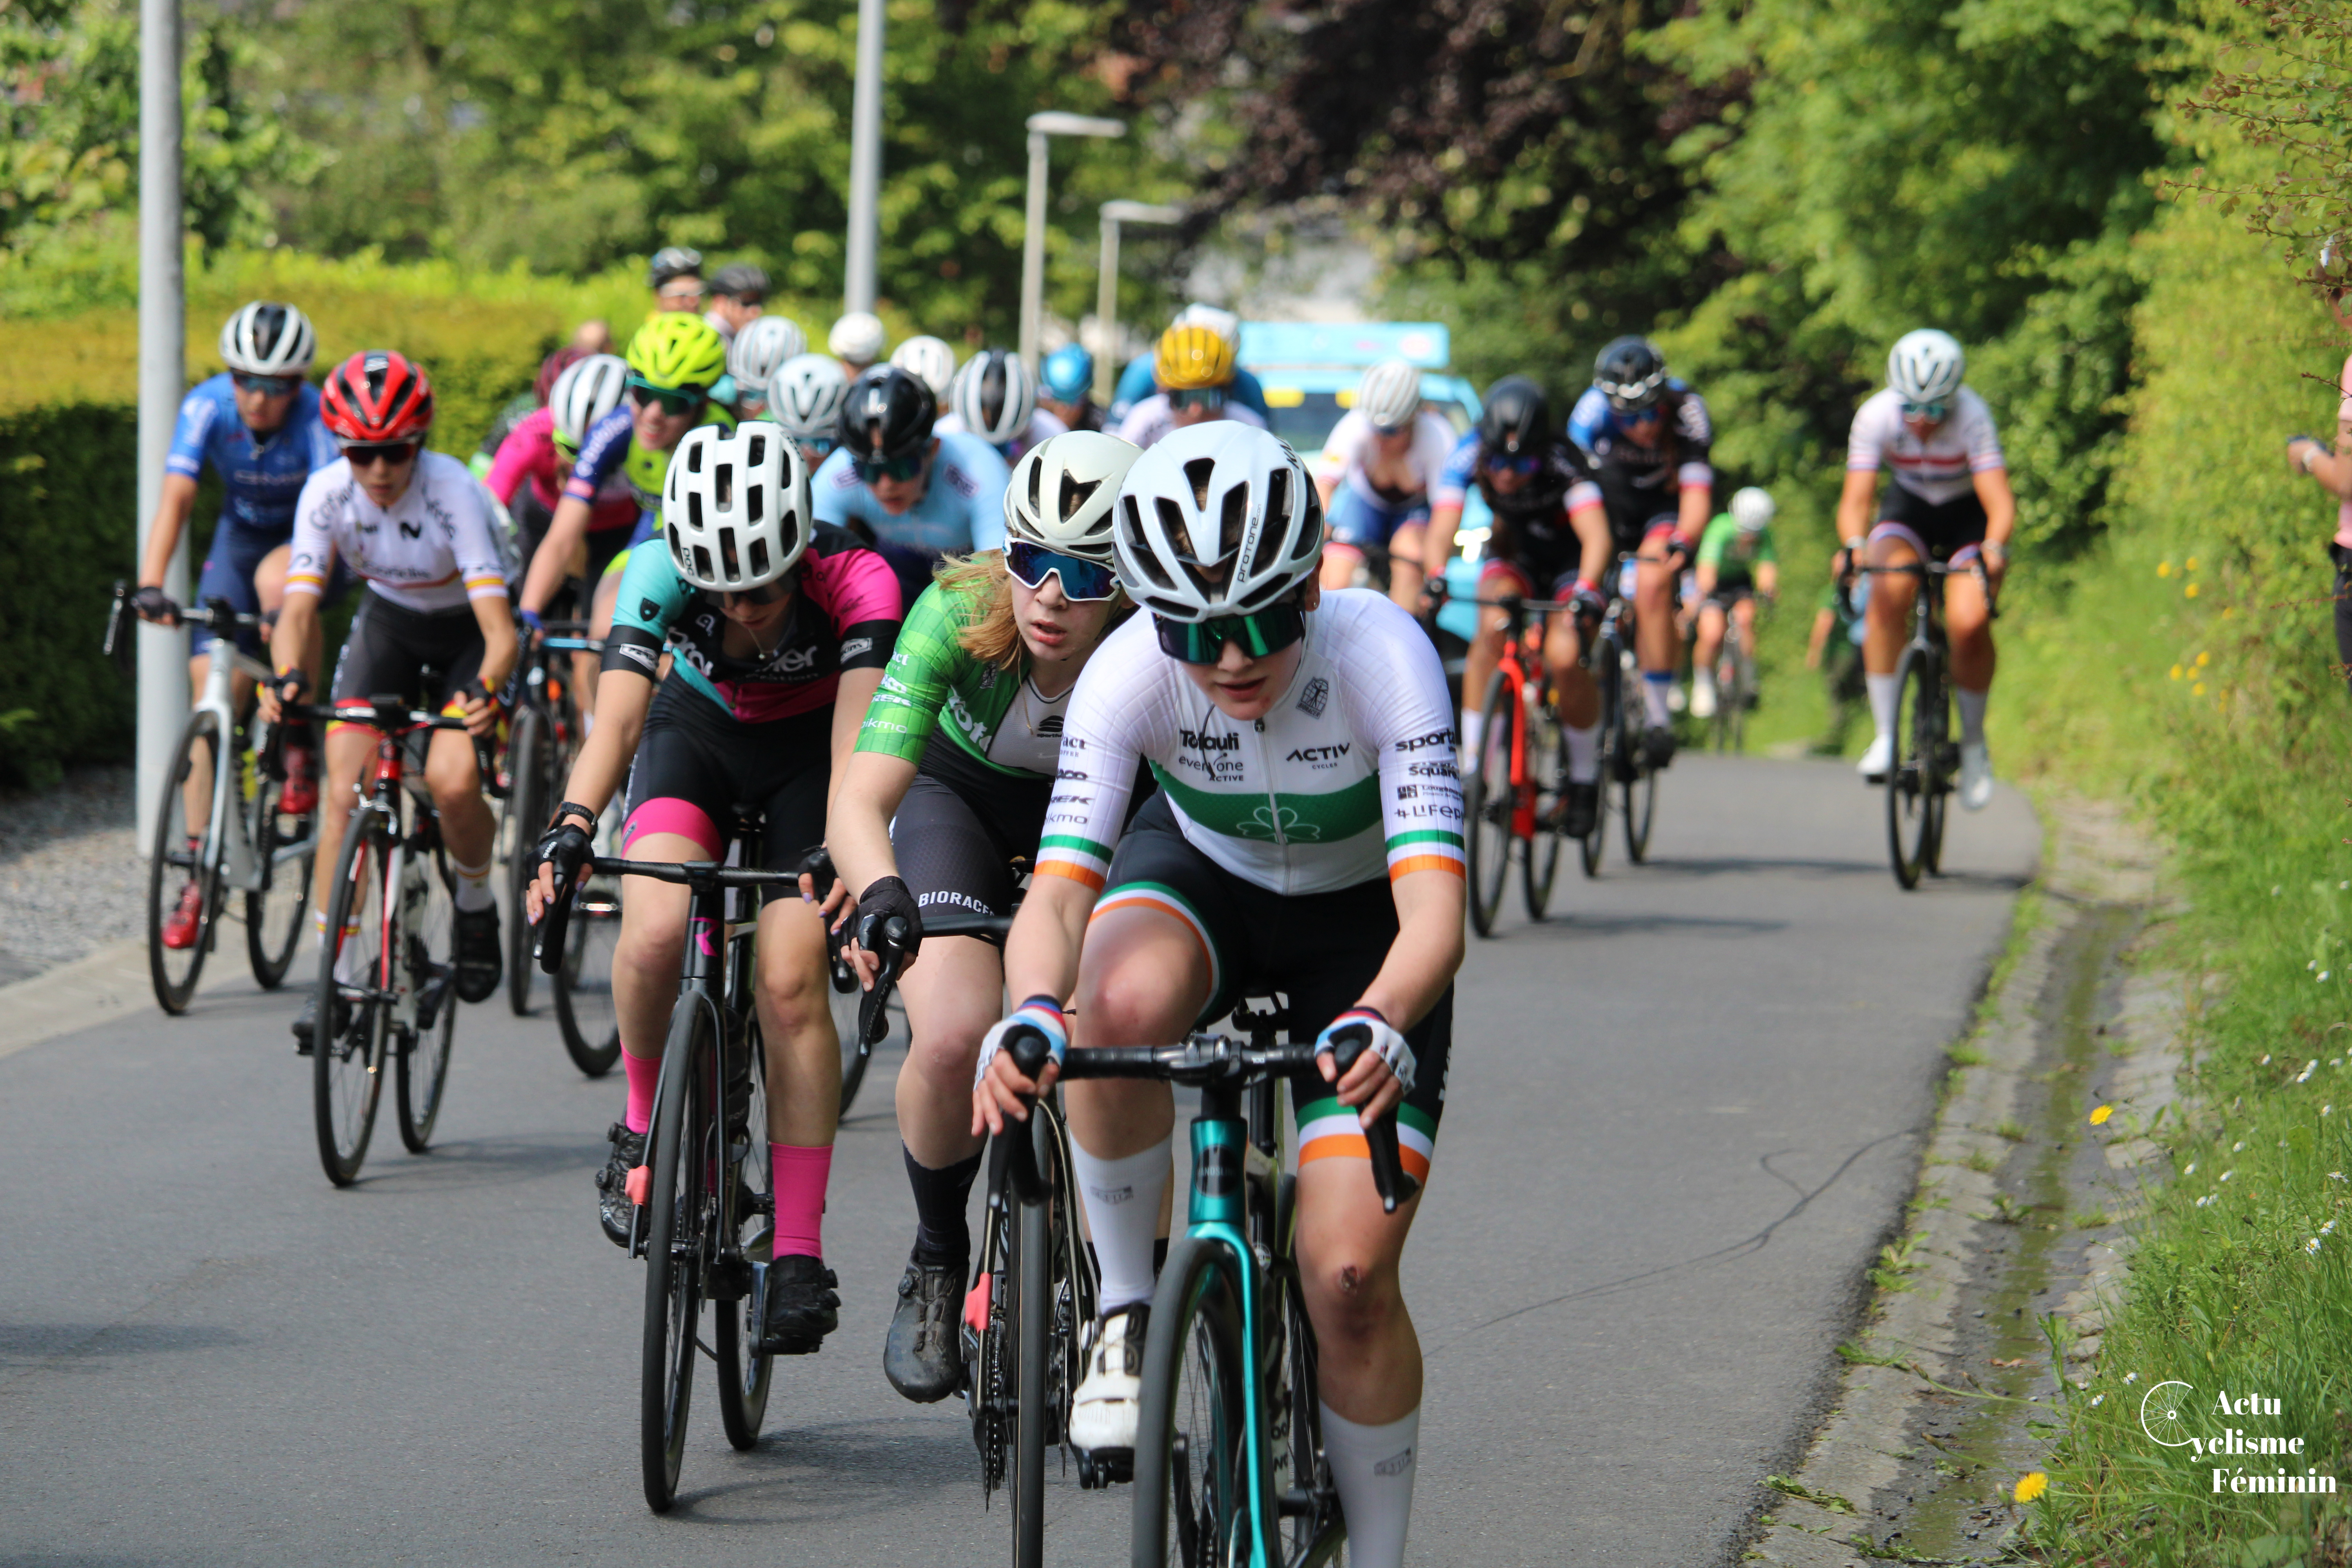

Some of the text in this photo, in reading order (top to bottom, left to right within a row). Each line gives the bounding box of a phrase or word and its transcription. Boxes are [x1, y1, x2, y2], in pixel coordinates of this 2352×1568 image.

[892, 648, 909, 666] act
[871, 694, 912, 706] REK
[1061, 731, 1086, 750] act
[1051, 795, 1096, 806] REK
[1044, 812, 1088, 825] ikmo
